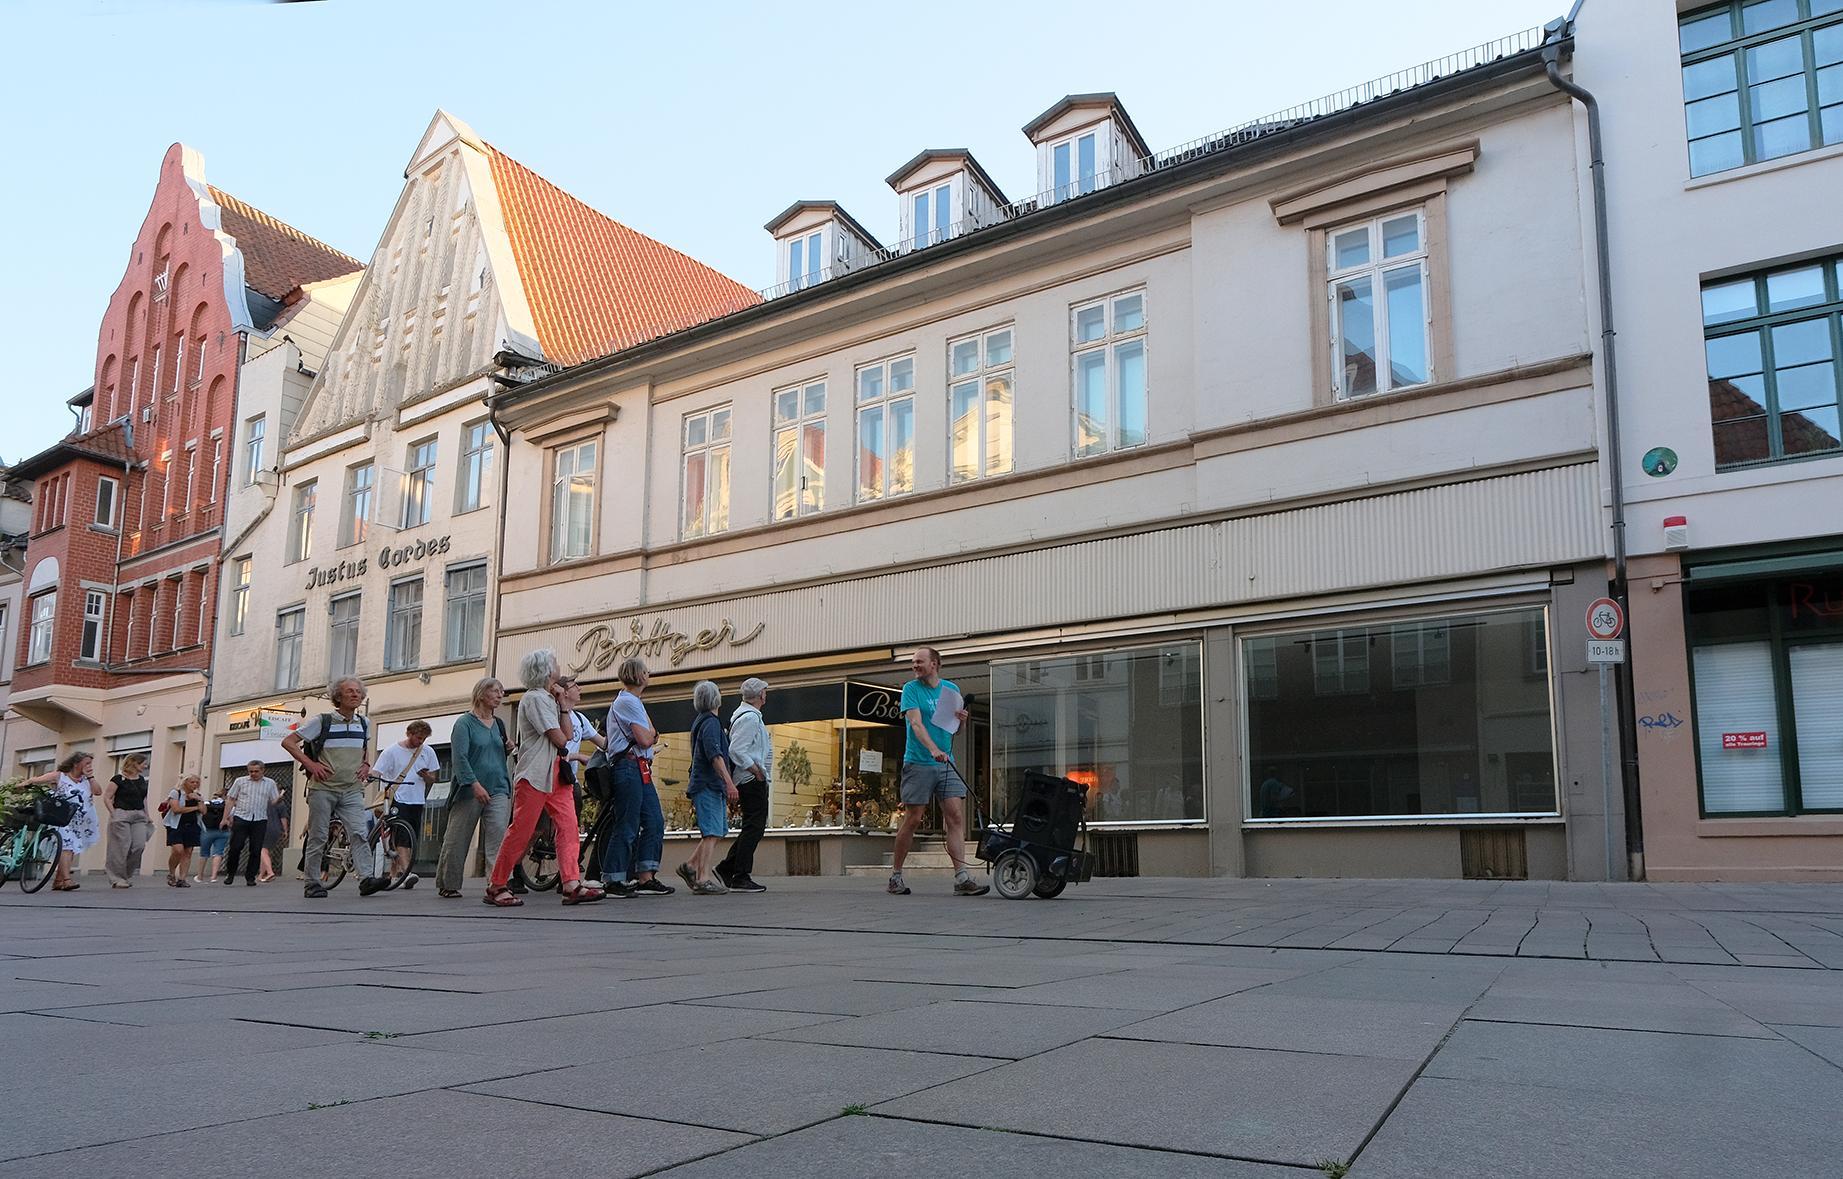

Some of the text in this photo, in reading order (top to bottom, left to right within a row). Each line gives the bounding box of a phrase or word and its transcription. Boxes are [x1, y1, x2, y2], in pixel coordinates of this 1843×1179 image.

[305, 535, 451, 590] Justus Cordes
[568, 616, 765, 674] Böttger
